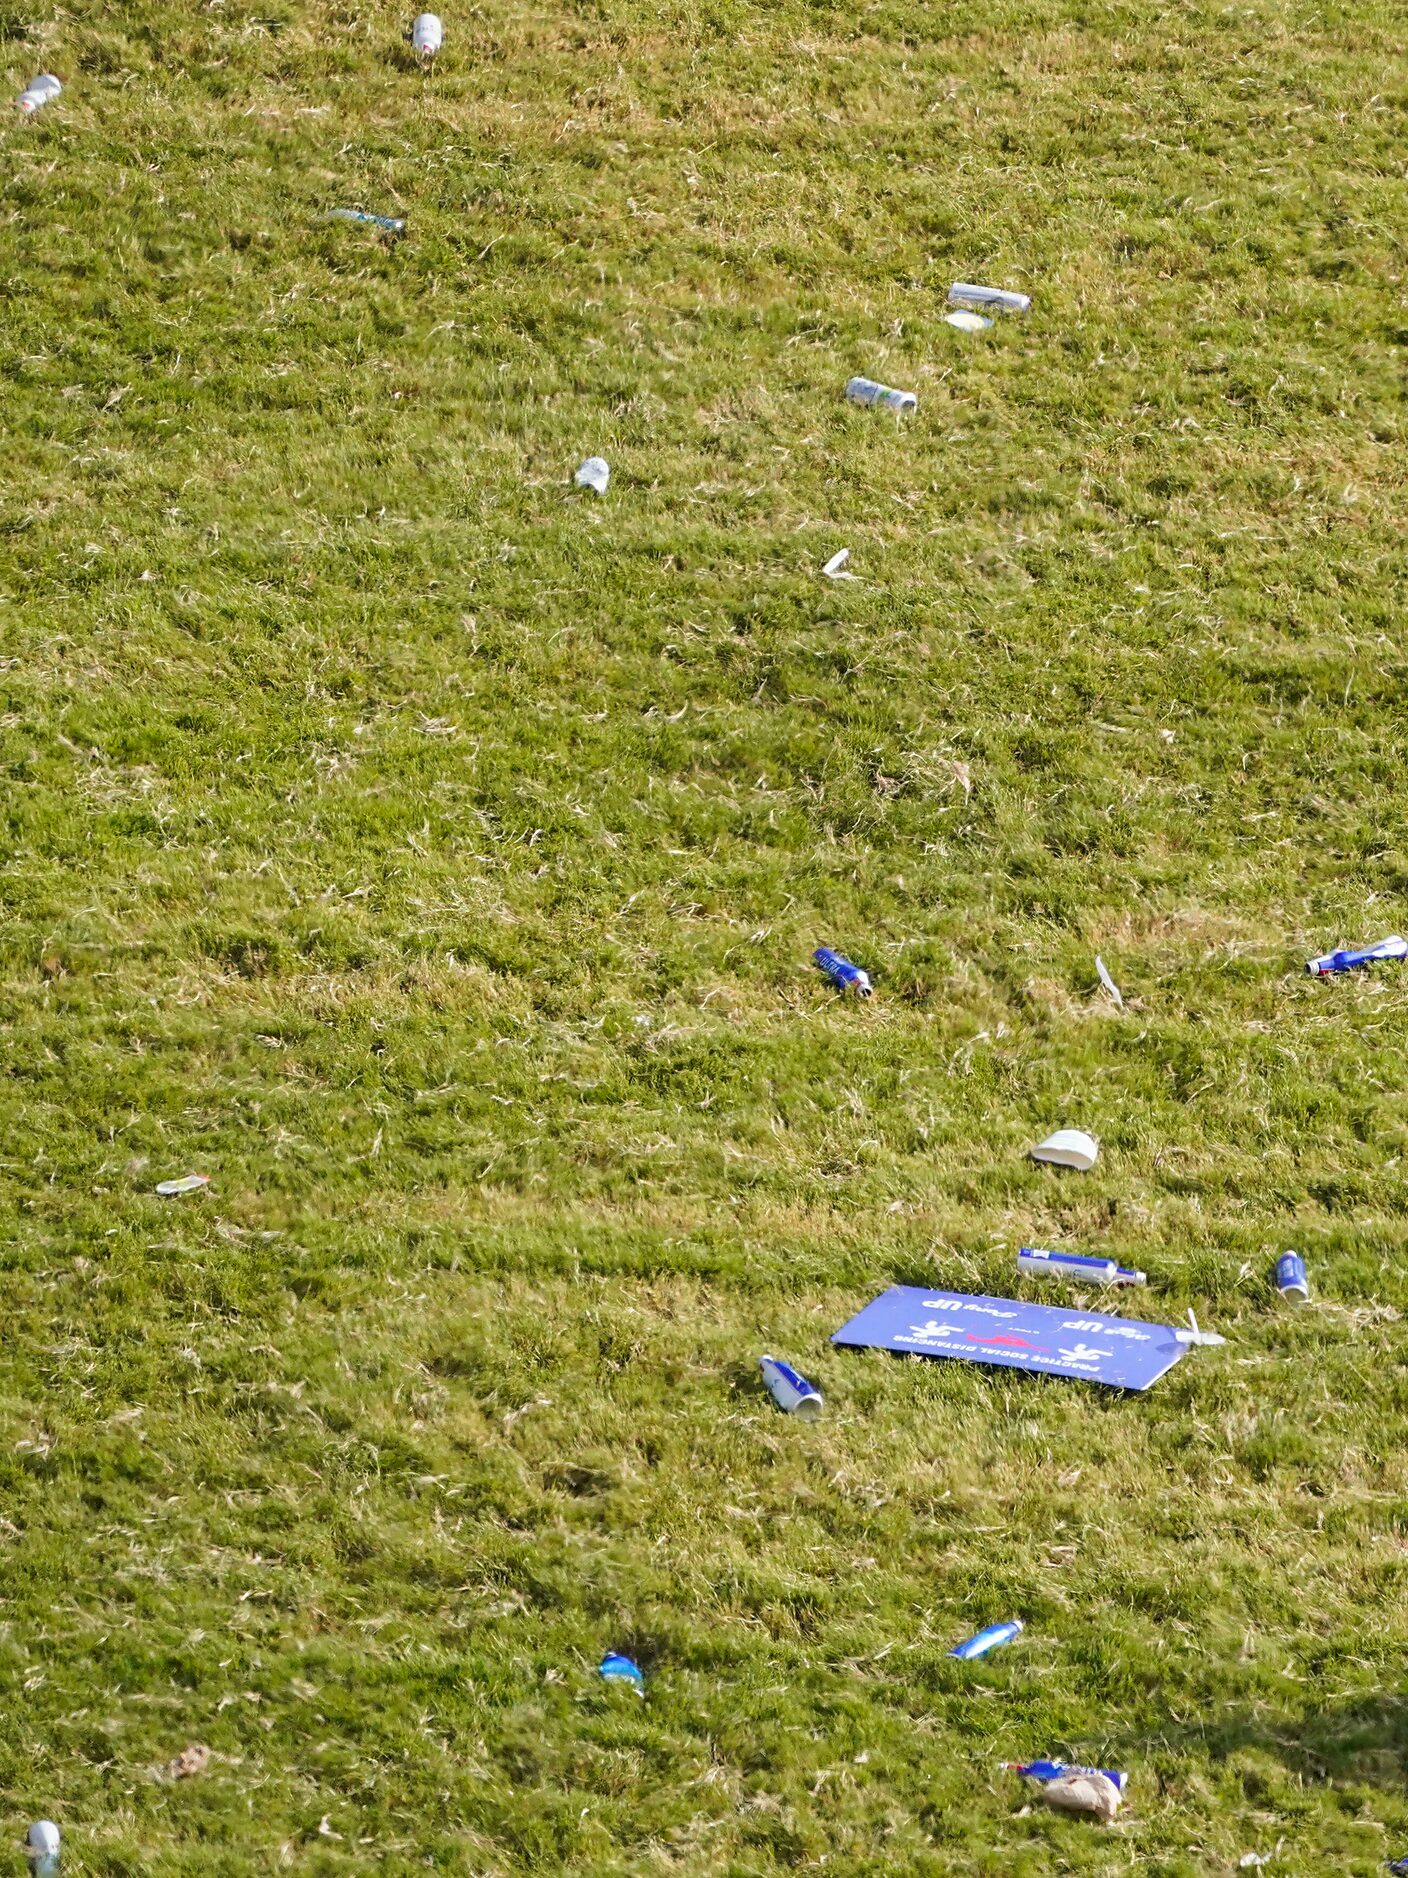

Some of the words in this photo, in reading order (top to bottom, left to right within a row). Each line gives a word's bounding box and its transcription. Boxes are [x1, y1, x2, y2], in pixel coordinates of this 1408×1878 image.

[819, 957, 840, 976] ULTRA
[922, 1298, 963, 1311] UP
[963, 1304, 1018, 1318] Pony
[1062, 1320, 1104, 1333] UP
[893, 1335, 977, 1352] DISTANCING
[981, 1347, 1029, 1360] SOCIAL
[1031, 1355, 1100, 1372] PRACTICE
